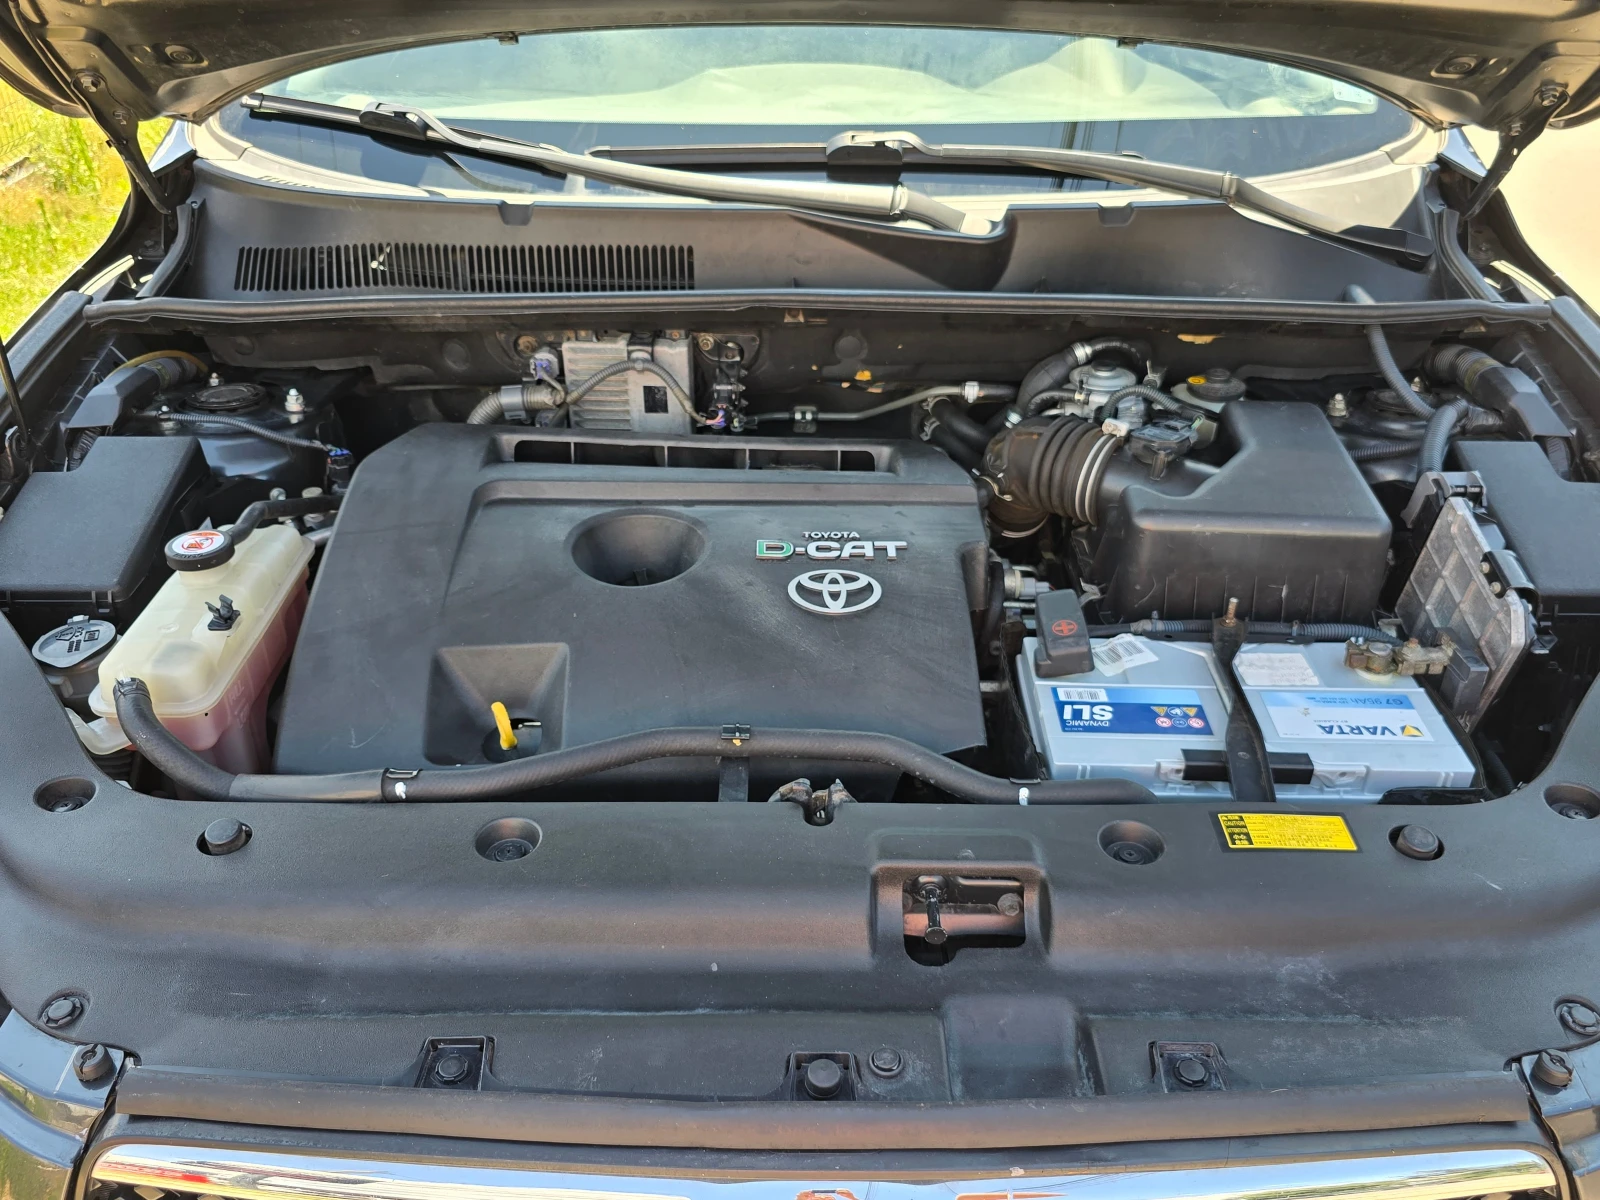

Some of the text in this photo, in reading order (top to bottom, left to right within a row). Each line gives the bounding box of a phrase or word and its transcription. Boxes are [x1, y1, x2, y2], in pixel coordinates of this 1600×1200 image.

[802, 531, 860, 539] TOYOTA
[756, 539, 908, 560] D-CAT
[1063, 704, 1114, 720] SLI
[1316, 724, 1398, 736] VARTA
